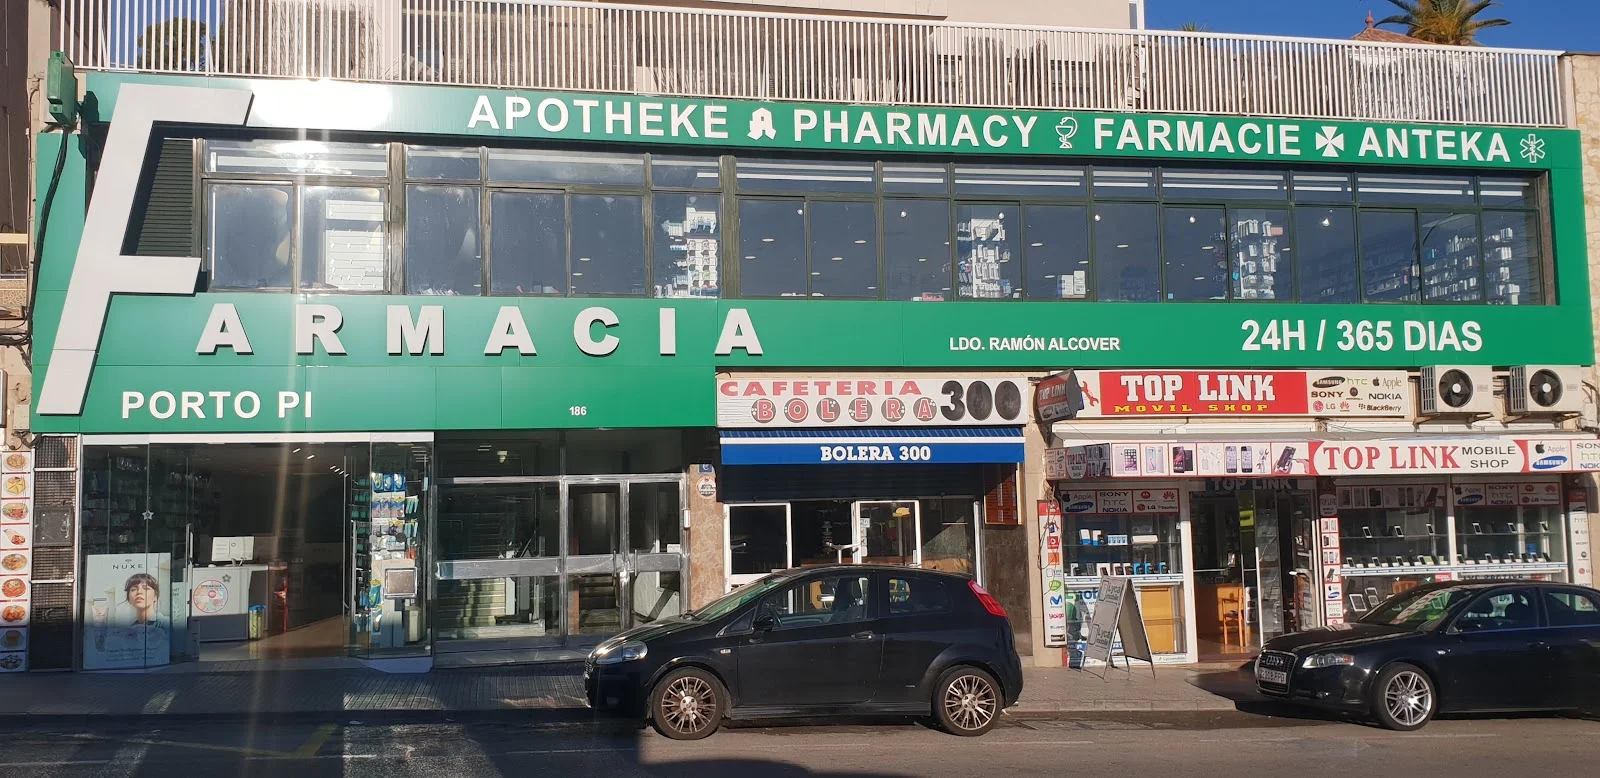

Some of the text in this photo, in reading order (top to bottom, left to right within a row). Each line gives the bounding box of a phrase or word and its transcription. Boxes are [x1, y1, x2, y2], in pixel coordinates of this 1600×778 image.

[467, 94, 1511, 163] APOTHEKE PHARMACY FARMACIE ANTEKA
[949, 334, 1121, 351] LDO. RAMÓN ALCOVER
[1241, 319, 1483, 352] 24H / 365 DIAS
[719, 380, 923, 396] CAFETERIA
[1120, 374, 1276, 402] TOP LINK
[1314, 378, 1343, 387] SAMSUNG
[1382, 376, 1402, 389] Apple
[121, 390, 312, 420] PORTO PI
[755, 380, 1022, 422] BOLERA 300
[1114, 403, 1269, 413] MOVIL SHOP
[569, 405, 587, 416] 186
[819, 445, 932, 461] BOLERA 300
[1462, 445, 1517, 456] MOBILE
[1547, 445, 1567, 453] Apple
[1323, 445, 1461, 471] TOP LINK
[1470, 459, 1510, 469] SHOP
[1534, 457, 1565, 468] SAMSUNG
[1210, 478, 1293, 490] TOP LINK
